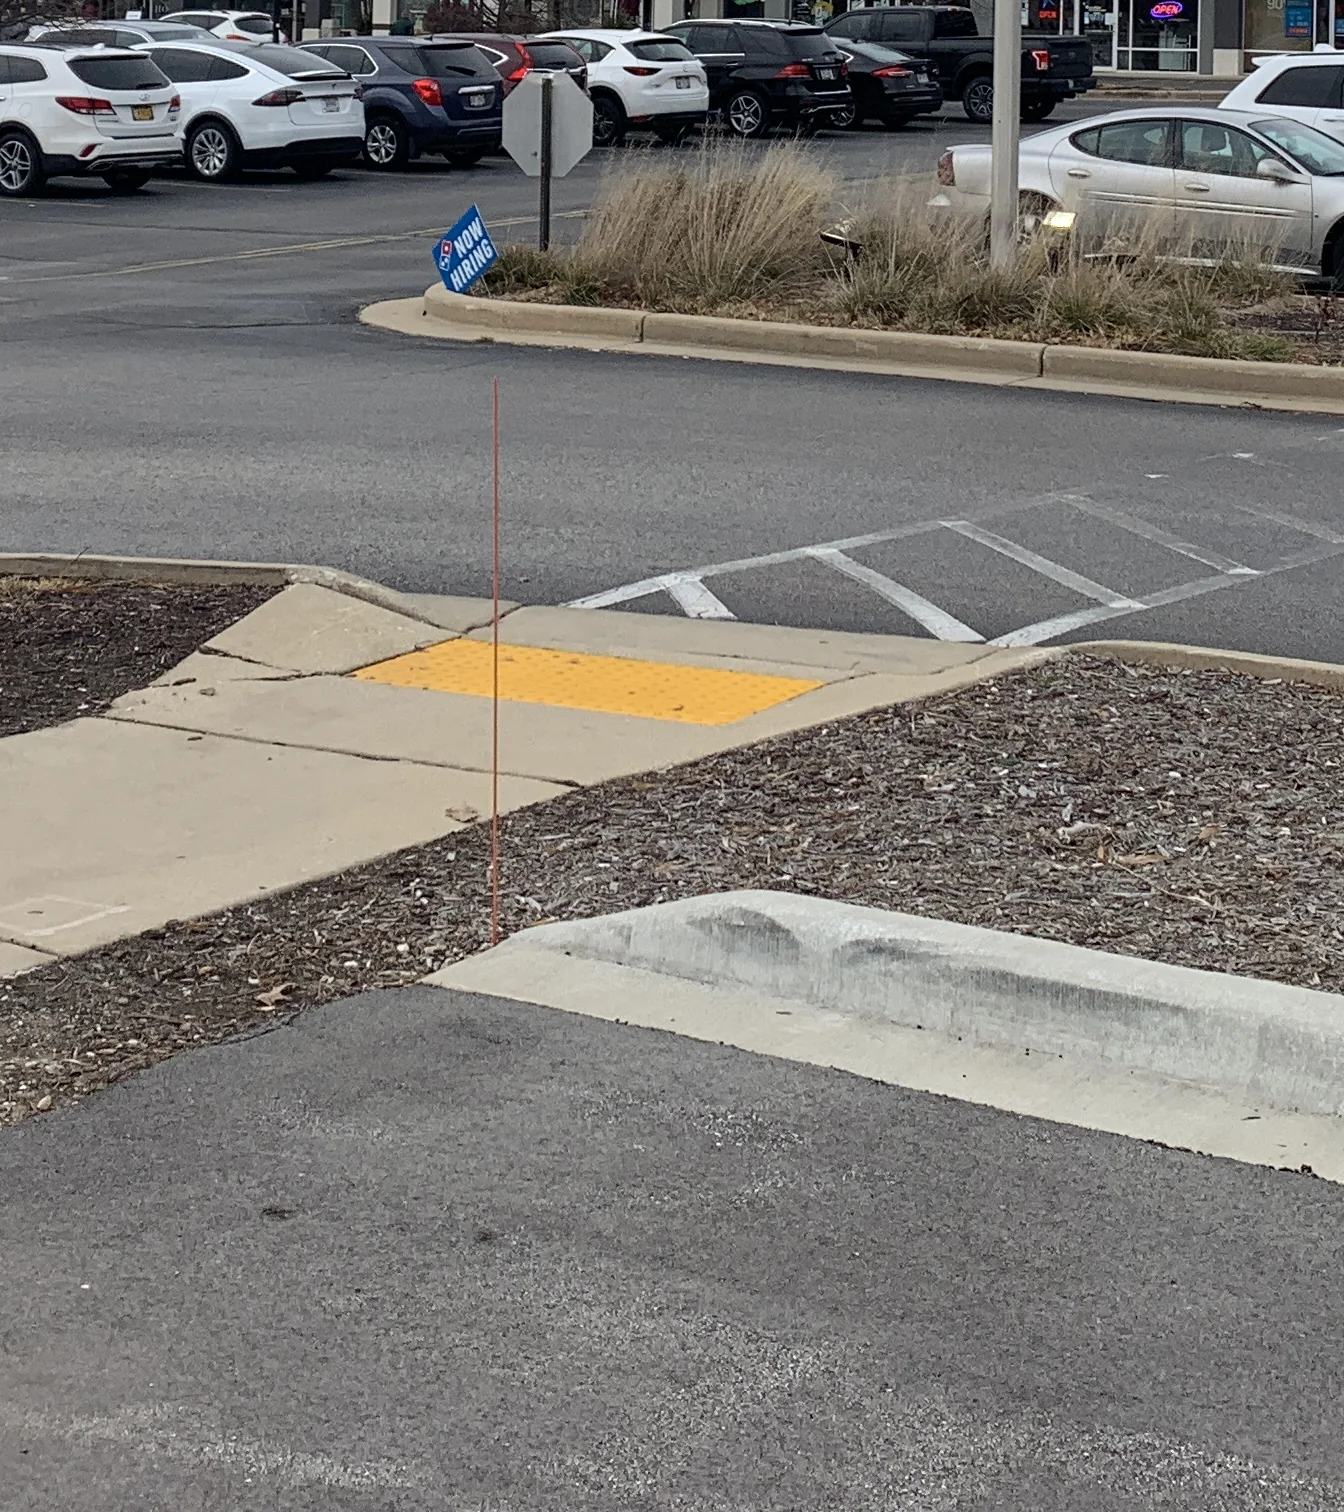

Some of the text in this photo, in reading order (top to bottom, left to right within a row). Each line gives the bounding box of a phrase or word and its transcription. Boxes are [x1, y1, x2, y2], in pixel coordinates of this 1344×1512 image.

[1154, 4, 1179, 15] OPEN
[454, 216, 483, 259] NOW
[450, 238, 494, 291] HIRING
